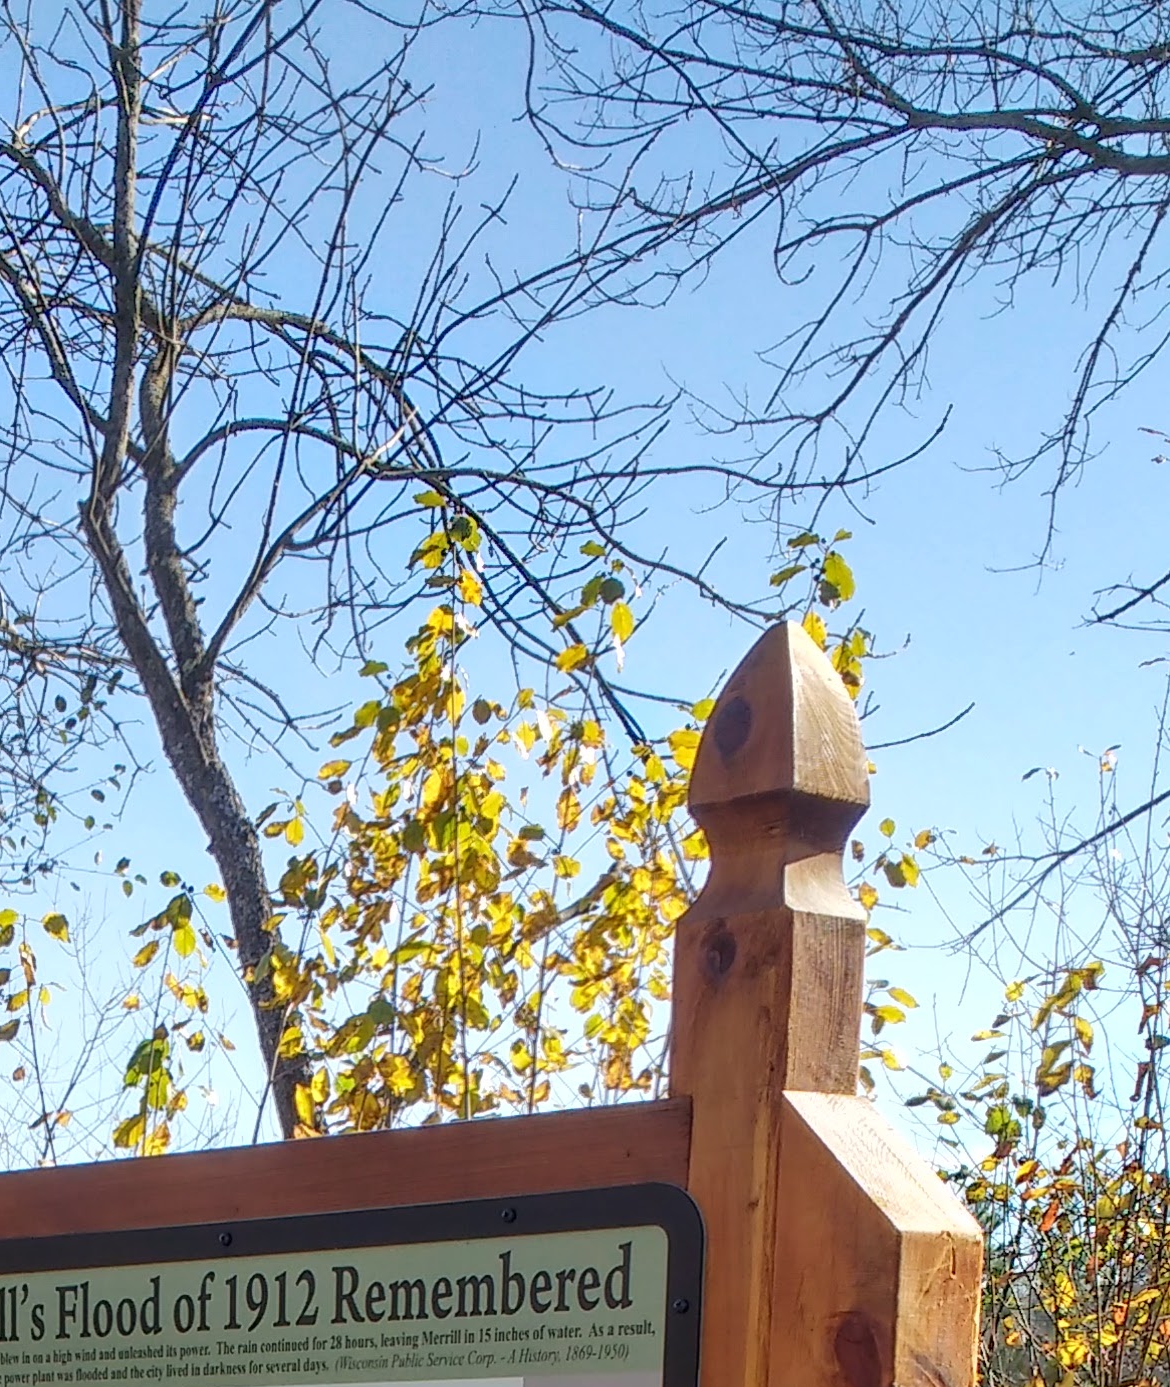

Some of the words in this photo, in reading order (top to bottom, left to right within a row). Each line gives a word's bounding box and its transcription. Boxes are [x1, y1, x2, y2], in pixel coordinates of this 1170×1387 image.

[55, 1275, 162, 1340] Flood
[173, 1271, 215, 1333] of
[224, 1269, 319, 1332] 1912
[331, 1241, 633, 1325] Remembered
[0, 1352, 19, 1365] blew
[21, 1350, 30, 1364] in
[32, 1353, 43, 1363] on
[45, 1353, 50, 1363] a
[52, 1349, 72, 1366] high
[74, 1347, 96, 1361] wind
[98, 1346, 115, 1360] and
[117, 1344, 163, 1359] unleashed
[165, 1344, 177, 1357] its
[179, 1345, 210, 1360] power.
[215, 1340, 234, 1355] The
[237, 1339, 257, 1354] rain
[260, 1336, 309, 1353] continued
[312, 1335, 328, 1350] for
[329, 1334, 342, 1349] 28
[344, 1334, 377, 1349] hours,
[380, 1332, 419, 1349] leaving
[421, 1329, 461, 1345] Merrill
[463, 1328, 474, 1343] in
[478, 1327, 491, 1343] 15
[494, 1326, 529, 1342] inches
[532, 1324, 545, 1340] of
[547, 1325, 582, 1339] water.
[588, 1322, 603, 1337] As
[606, 1324, 614, 1336] a
[617, 1319, 655, 1336] result,
[3, 1373, 30, 1387] power
[32, 1369, 54, 1386] plant
[56, 1371, 73, 1381] was
[75, 1366, 108, 1381] flooded
[110, 1366, 128, 1379] and
[130, 1364, 144, 1378] the
[145, 1364, 164, 1381] city
[165, 1362, 188, 1377] lived
[190, 1362, 200, 1376] in
[202, 1361, 246, 1376] darkness
[248, 1359, 263, 1374] for
[265, 1357, 300, 1373] several
[334, 1355, 388, 1371] (Wisconsin
[391, 1352, 424, 1368] Public
[426, 1351, 464, 1367] Service
[506, 1348, 516, 1364] A
[565, 1343, 629, 1361] 1869-1950)
